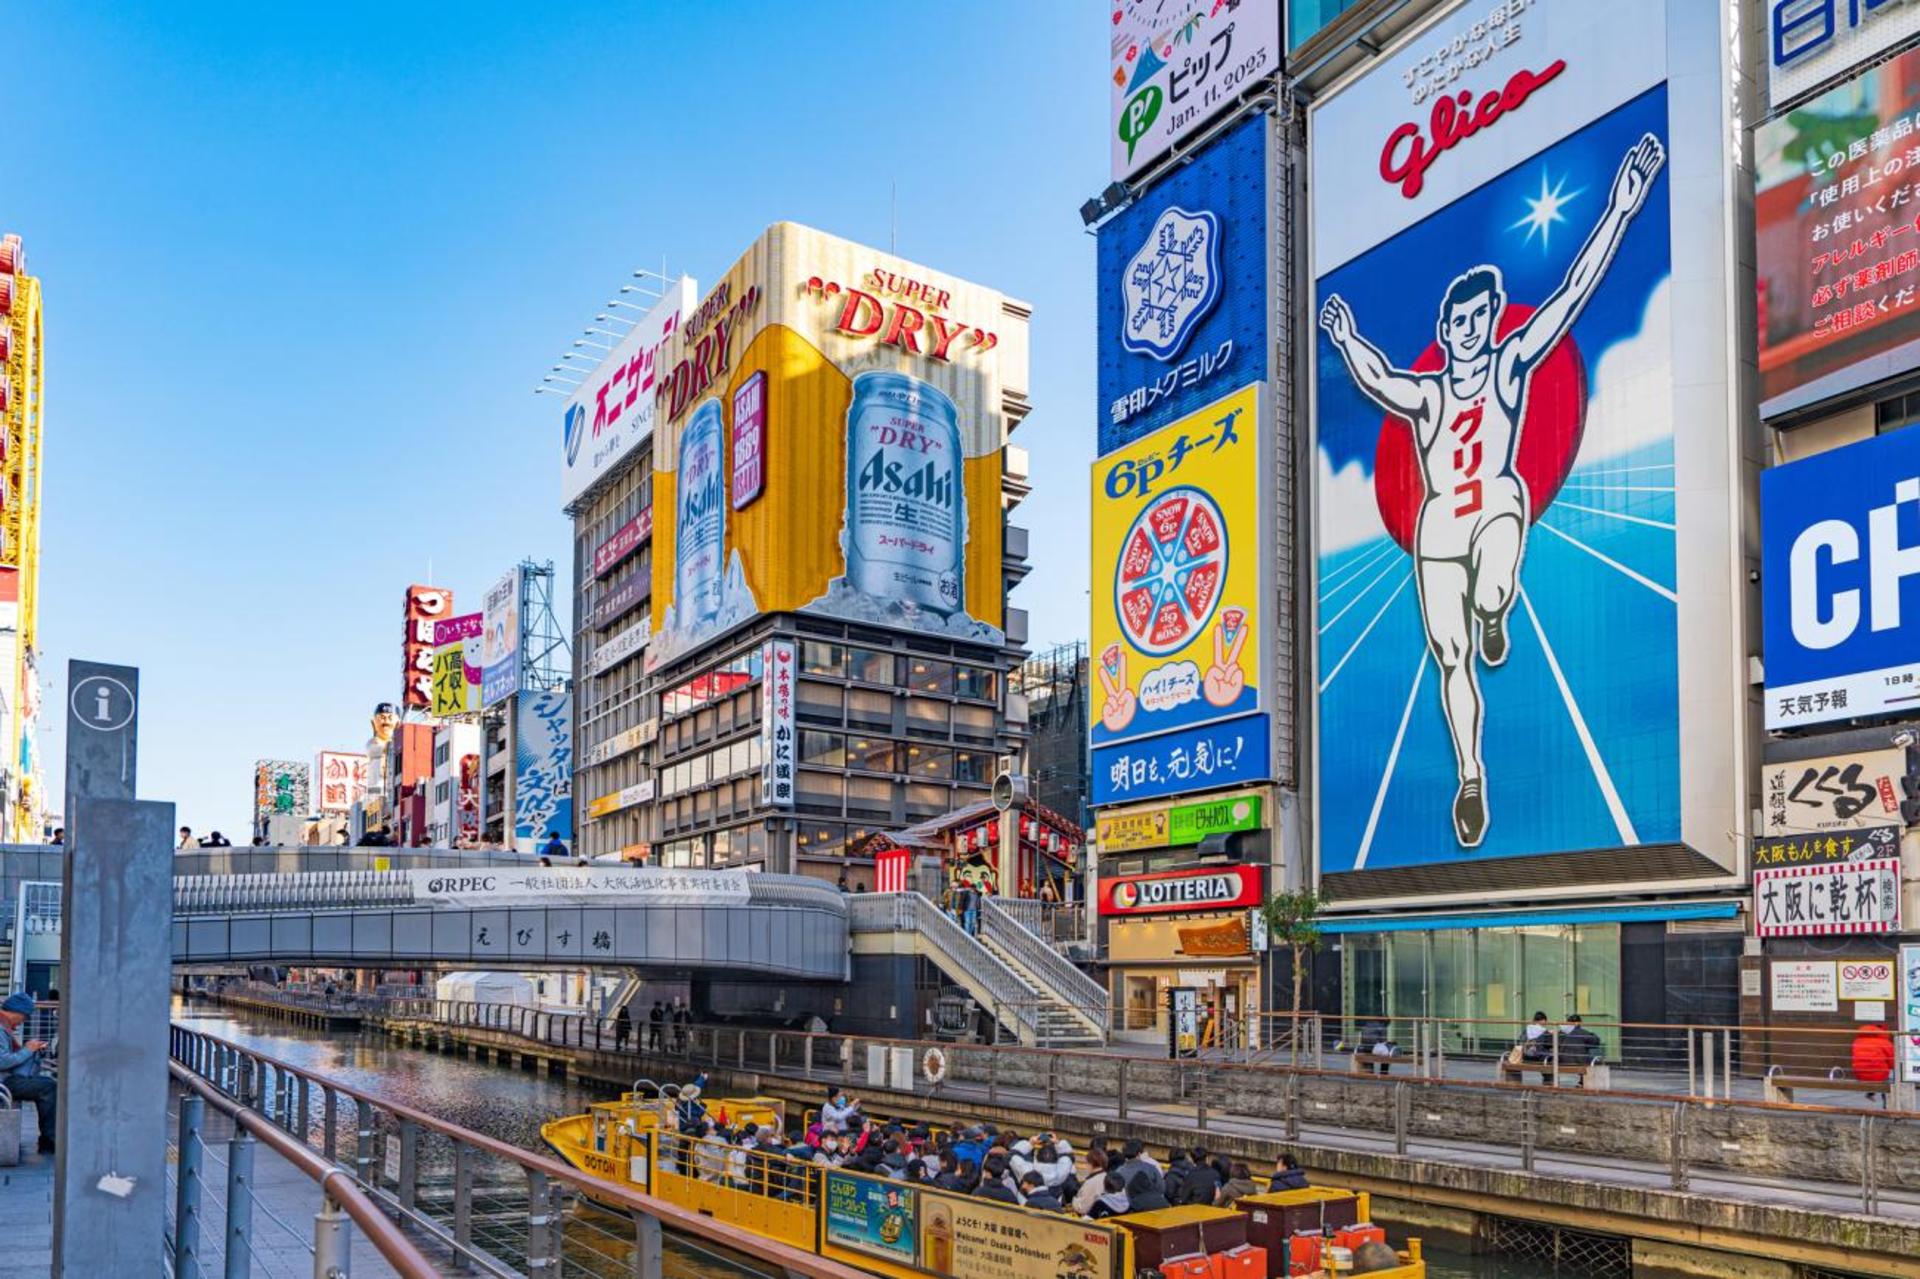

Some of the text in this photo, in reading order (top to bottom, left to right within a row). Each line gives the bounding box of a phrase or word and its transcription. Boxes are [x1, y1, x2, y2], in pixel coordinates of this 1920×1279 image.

[1168, 21, 1236, 105] ピップ
[1166, 104, 1201, 136] Jan.
[870, 267, 951, 310] SUPER
[1811, 247, 1920, 308] 必ず薬剤師
[1109, 339, 1233, 425] 雪印メグミルク
[888, 416, 925, 434] SUPER
[859, 447, 952, 510] Asahi
[1449, 396, 1486, 519] グリコ
[449, 650, 464, 711] 高収入
[1779, 688, 1848, 718] 天気予報
[1141, 878, 1229, 903] LOTTERIA
[1762, 872, 1878, 924] 大阪に乾杯
[475, 926, 613, 952] えびす橋
[583, 1154, 617, 1178] DOTON
[1084, 1231, 1109, 1246] KIRIN
